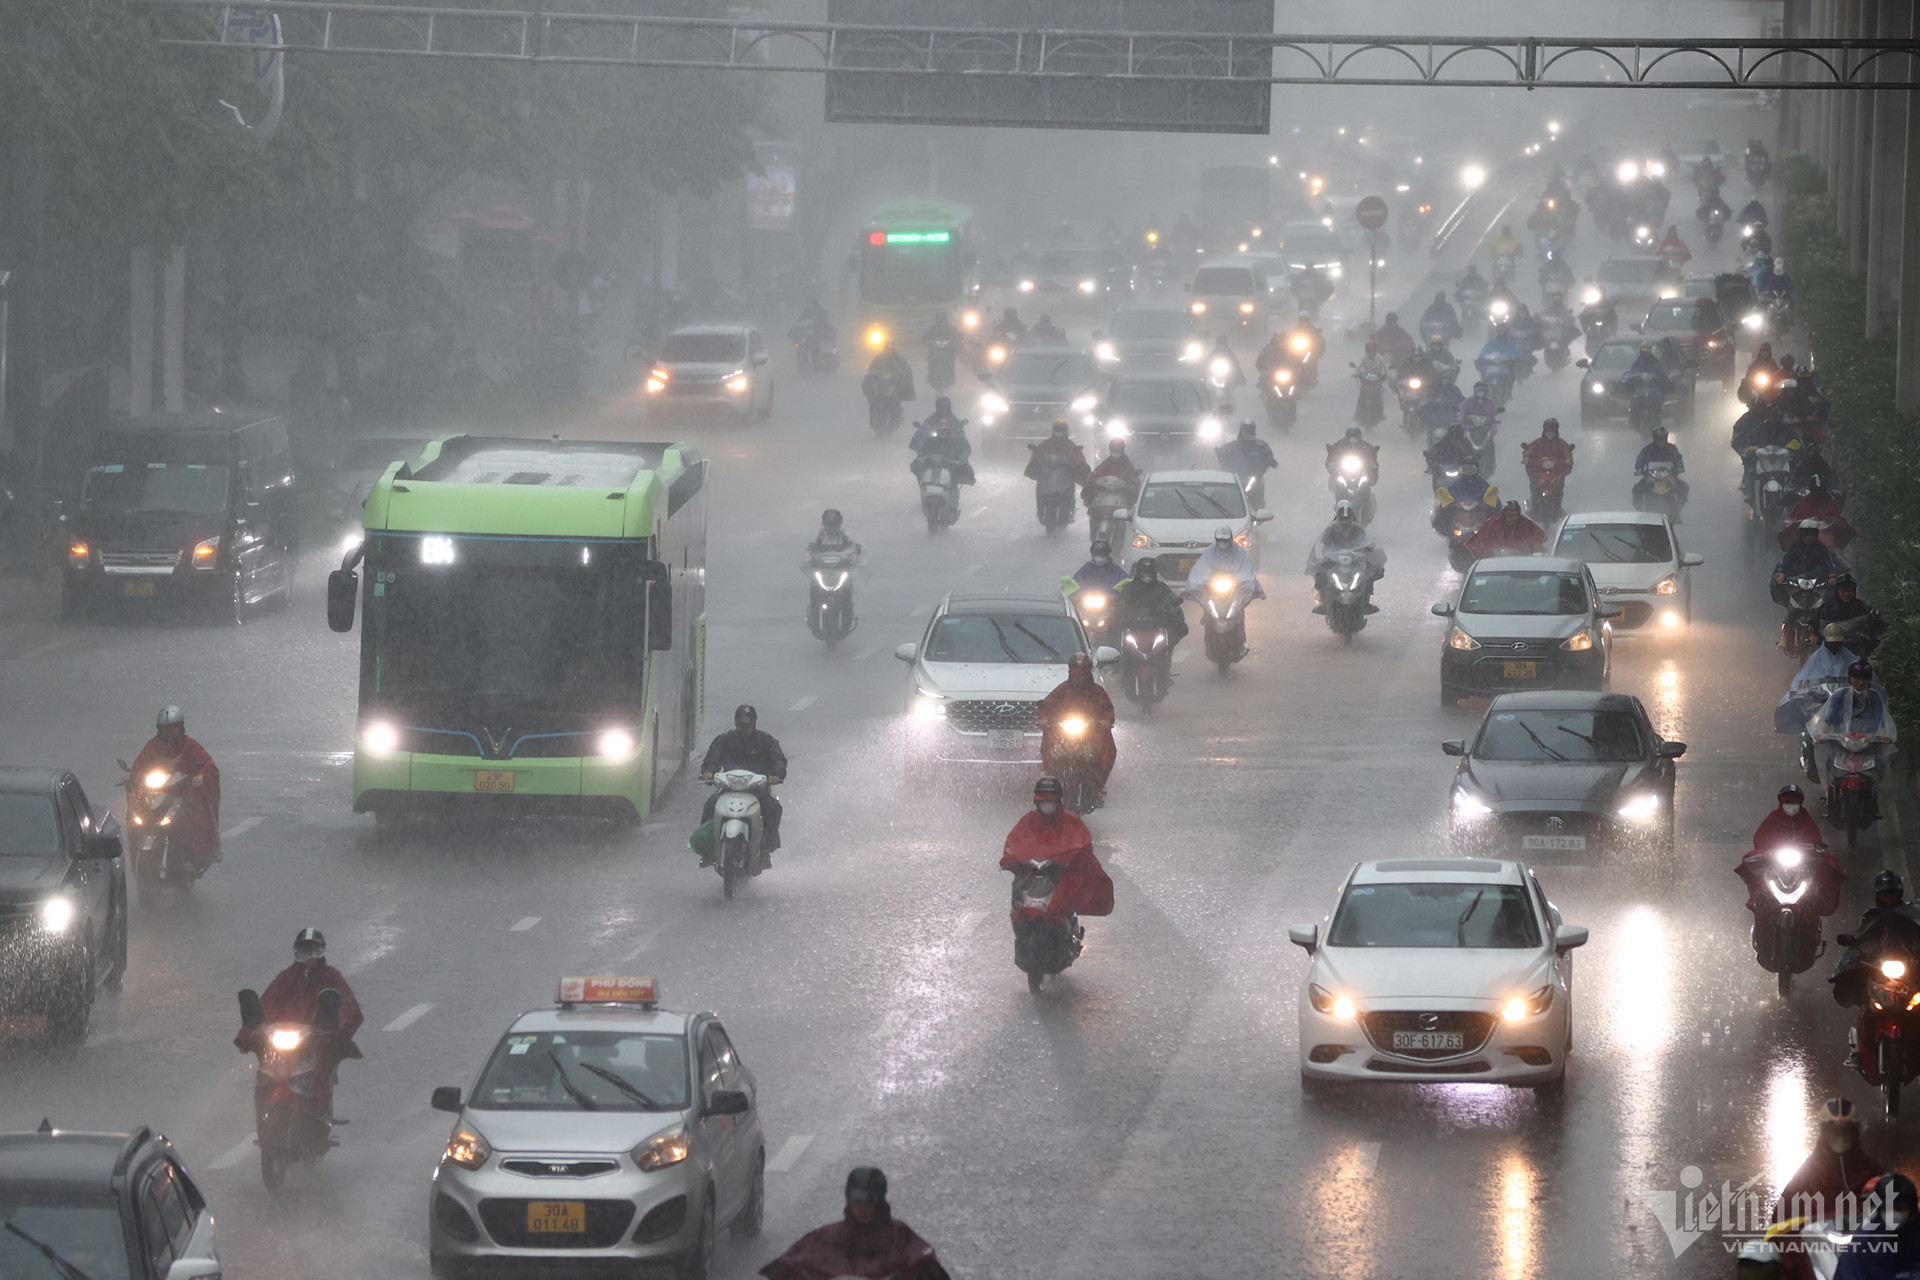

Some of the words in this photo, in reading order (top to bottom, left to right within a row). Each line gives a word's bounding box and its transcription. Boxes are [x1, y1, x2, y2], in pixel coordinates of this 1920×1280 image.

[1395, 1034, 1462, 1048] 30F-617.63
[551, 1164, 566, 1173] KIA
[544, 1204, 568, 1217] 30A
